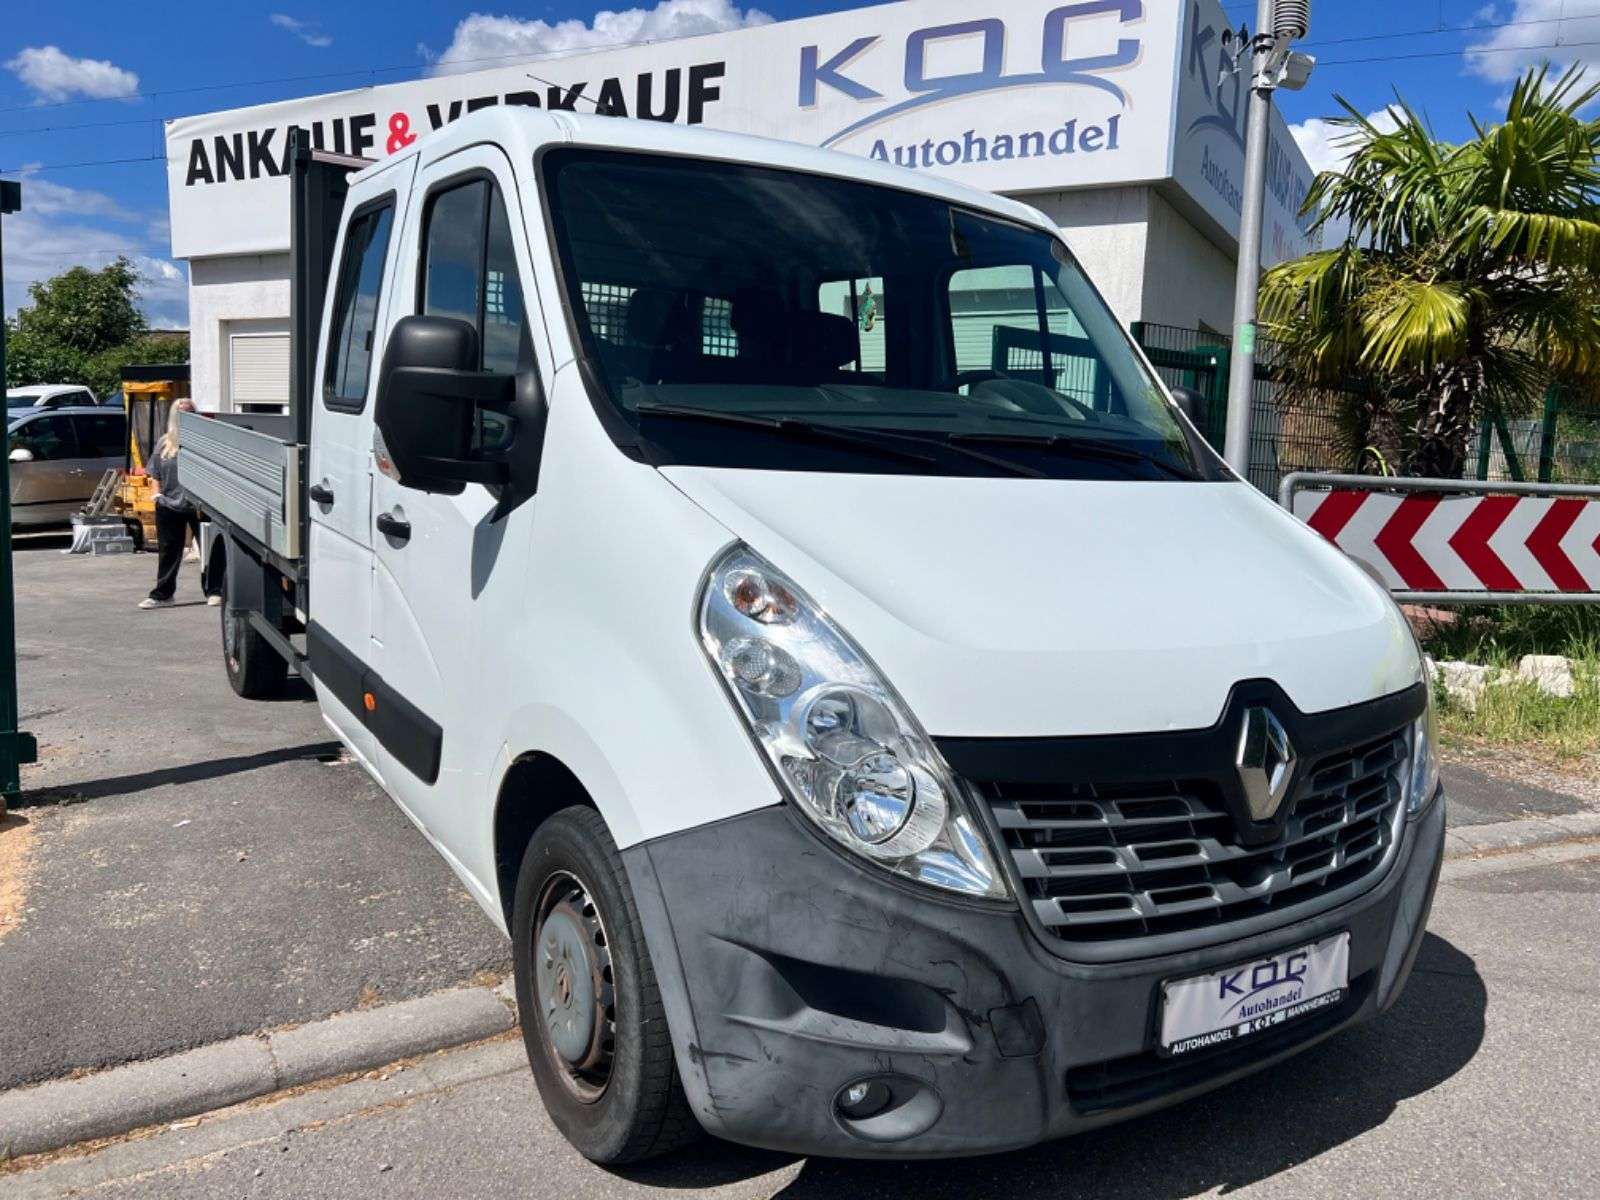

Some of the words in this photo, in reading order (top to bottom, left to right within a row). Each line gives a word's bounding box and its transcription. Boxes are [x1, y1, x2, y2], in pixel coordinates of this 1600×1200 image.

[387, 112, 417, 155] &
[869, 114, 1120, 169] Autohandel
[1238, 988, 1302, 1019] Autohandel
[1172, 1029, 1233, 1055] AUTOHANDEL
